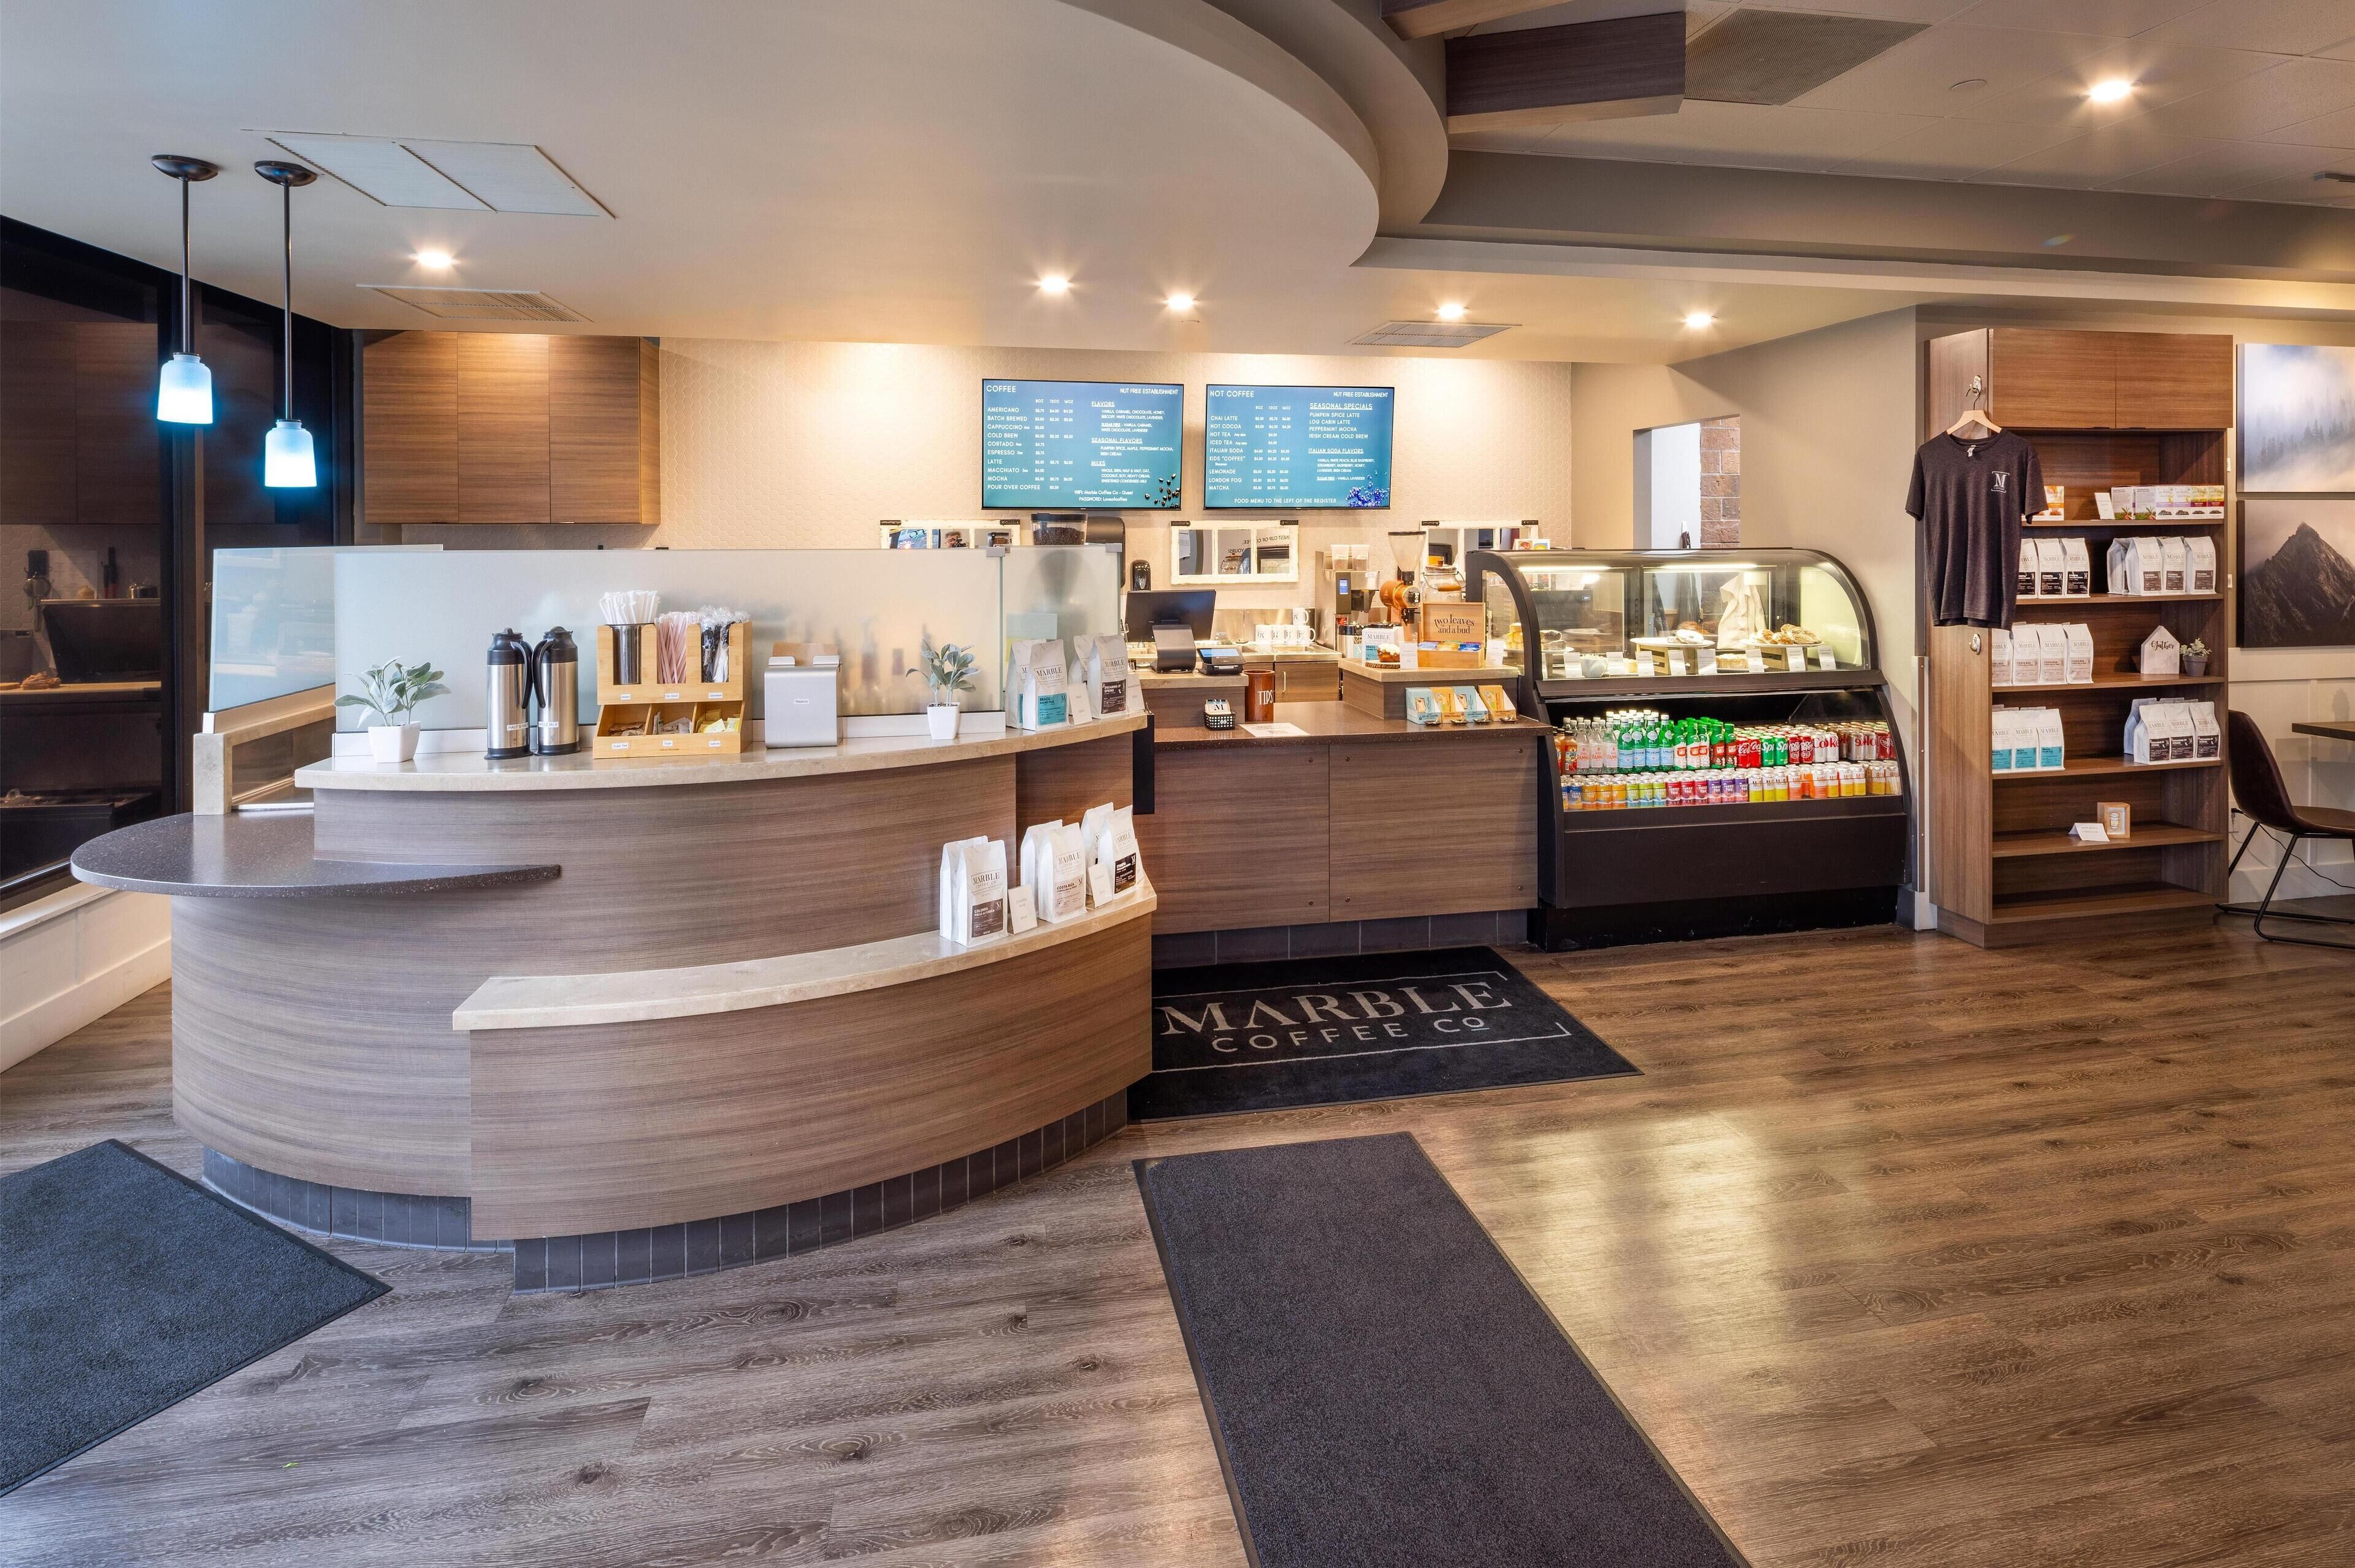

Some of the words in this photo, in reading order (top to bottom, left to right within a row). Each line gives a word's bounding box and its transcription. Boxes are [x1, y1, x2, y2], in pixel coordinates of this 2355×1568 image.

[1994, 473, 2007, 488] M
[1434, 618, 1448, 628] two
[1450, 614, 1475, 626] leaves
[2150, 640, 2174, 651] Gather
[1037, 667, 1062, 676] MARBLE
[1257, 690, 1273, 705] TIPS
[1059, 852, 1081, 865] MARBLE
[973, 873, 1000, 885] MARBLE
[1154, 981, 1512, 1035] MARBLE
[1211, 1023, 1408, 1053] COFFEE
